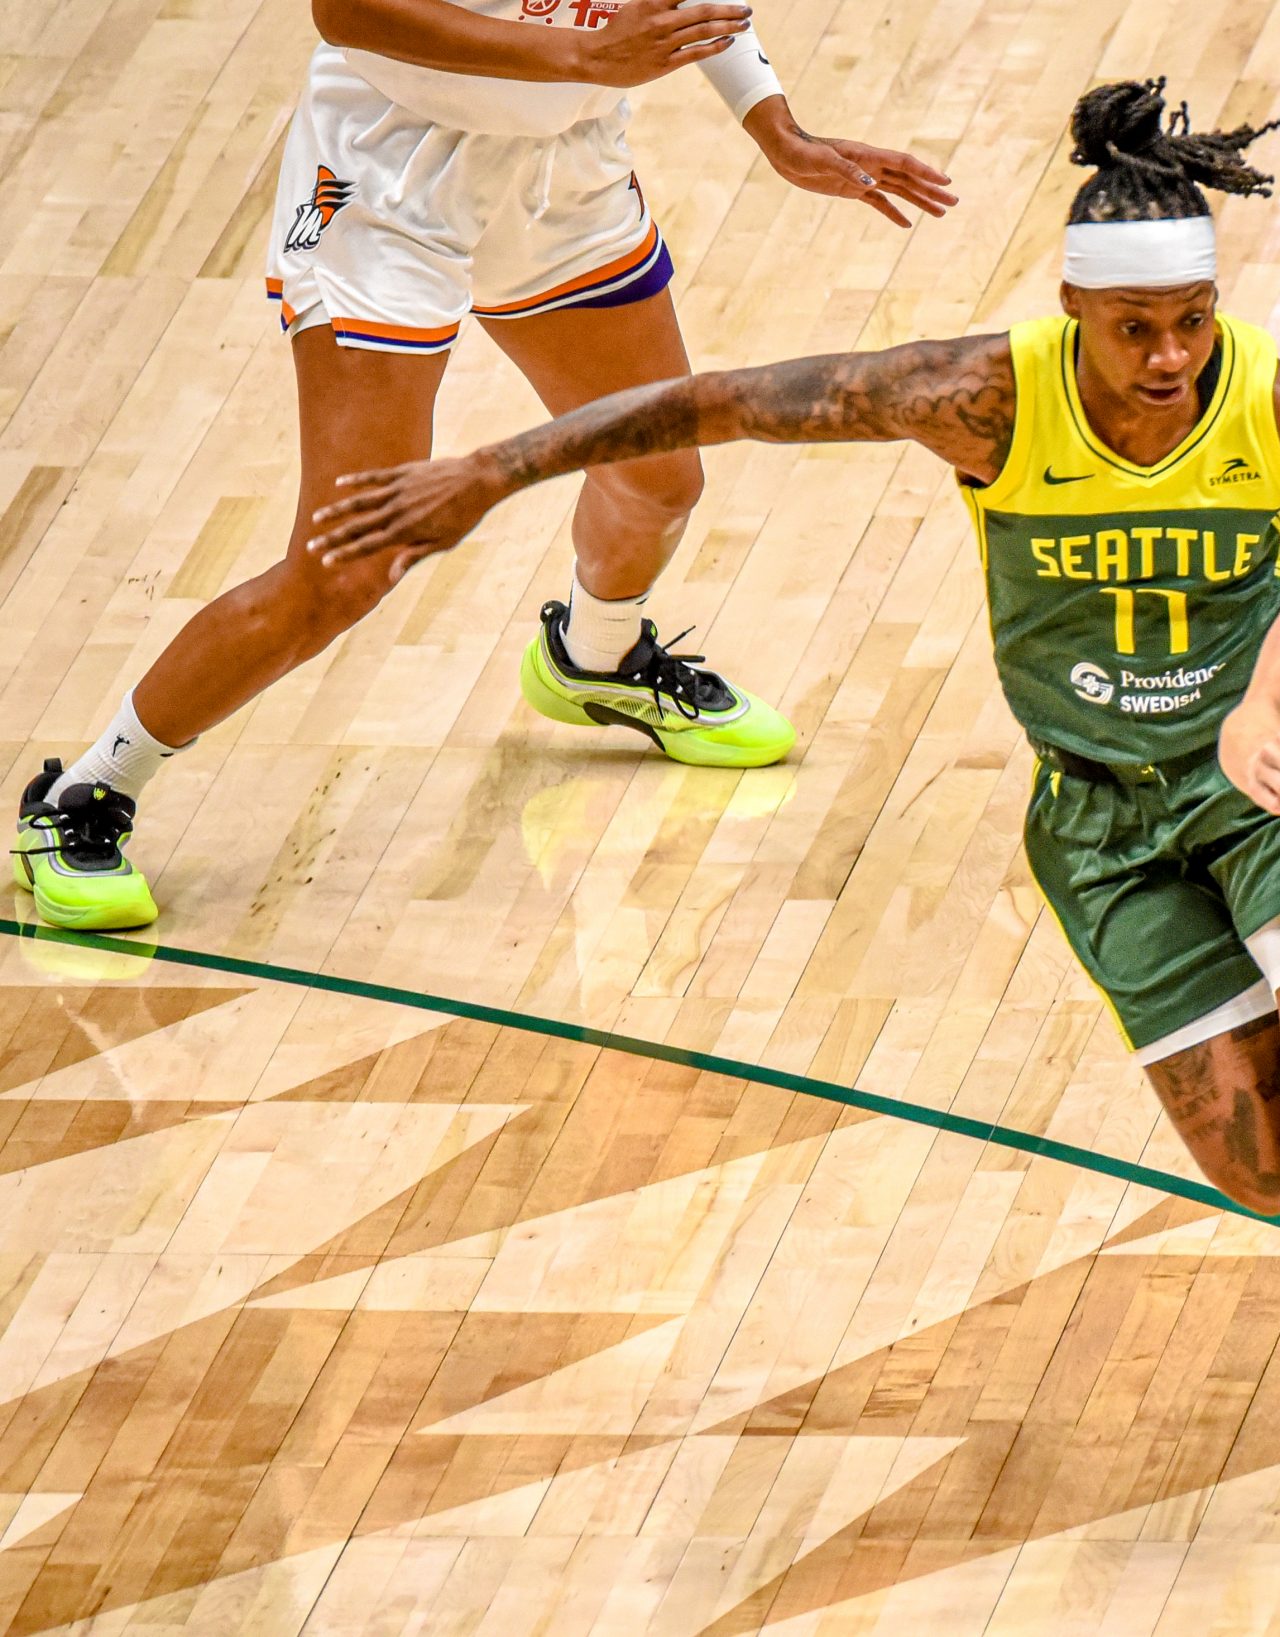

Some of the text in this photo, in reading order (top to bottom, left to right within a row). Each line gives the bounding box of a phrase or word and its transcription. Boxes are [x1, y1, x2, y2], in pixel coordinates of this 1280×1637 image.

[1209, 471, 1261, 487] SYMETRA
[1030, 527, 1260, 582] SEATTLE
[1099, 587, 1189, 656] 11
[1120, 662, 1226, 690] Providenc
[1120, 687, 1201, 714] SWEDISH
